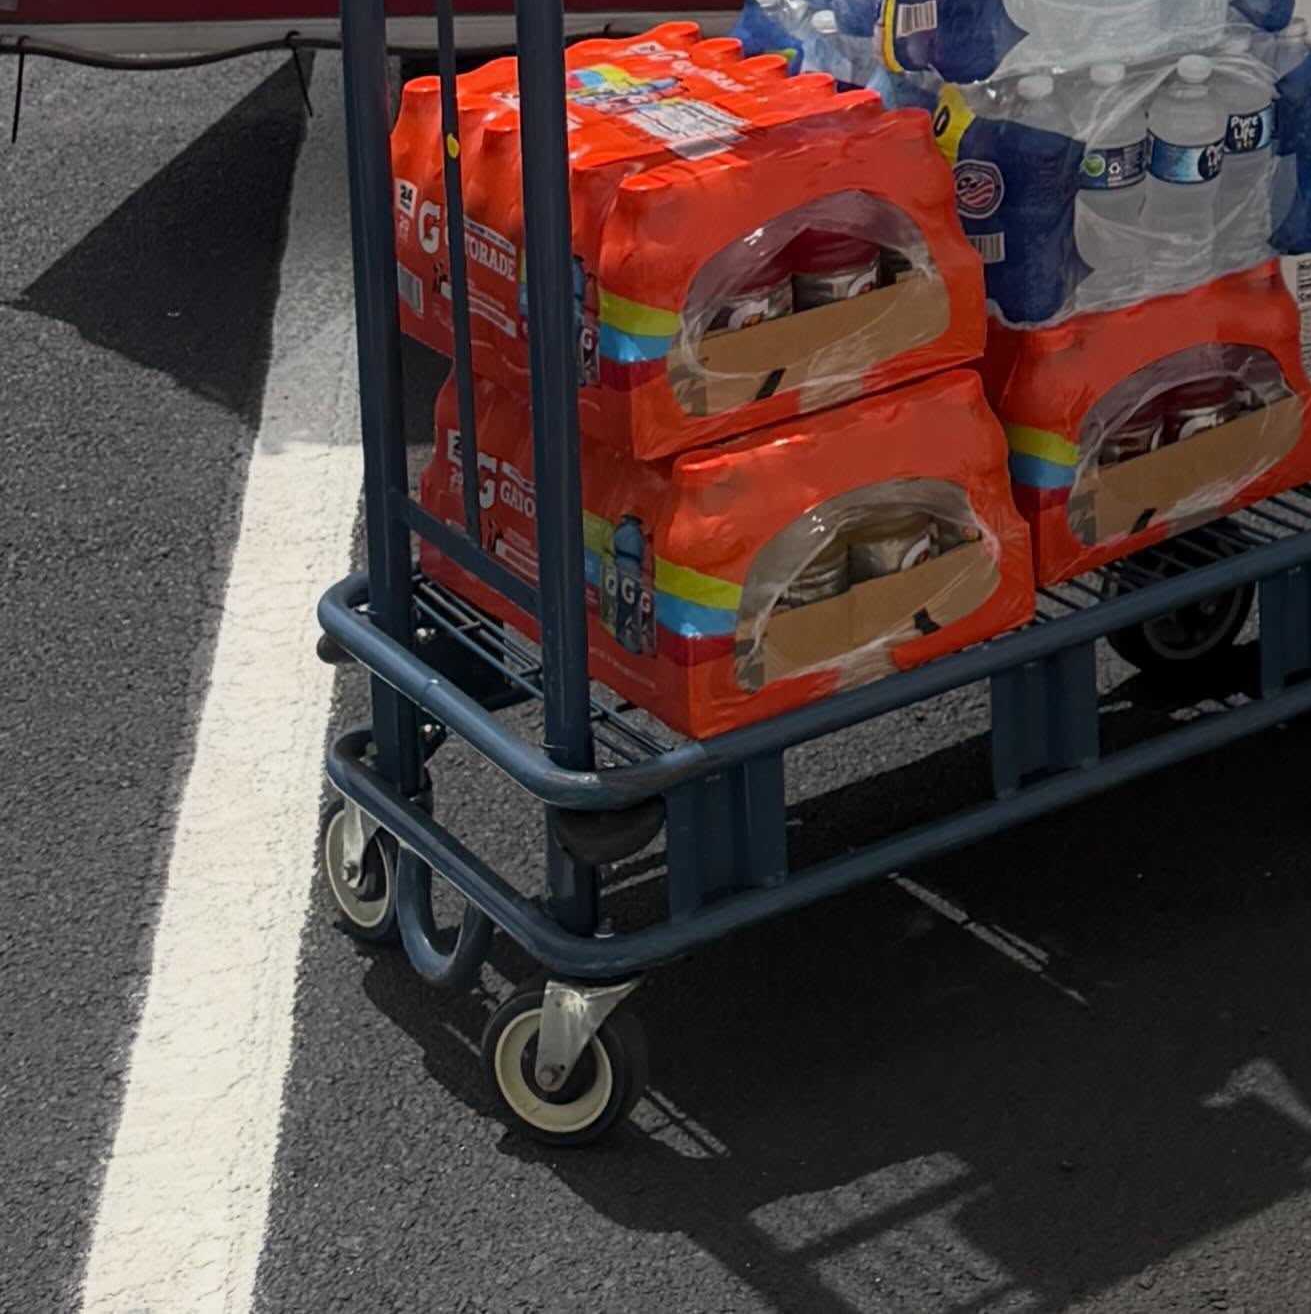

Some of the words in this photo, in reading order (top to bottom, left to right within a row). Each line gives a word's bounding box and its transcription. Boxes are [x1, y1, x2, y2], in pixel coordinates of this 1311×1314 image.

[1231, 115, 1259, 128] Pure
[1234, 127, 1256, 142] Life
[400, 184, 413, 202] 24
[417, 200, 441, 254] G
